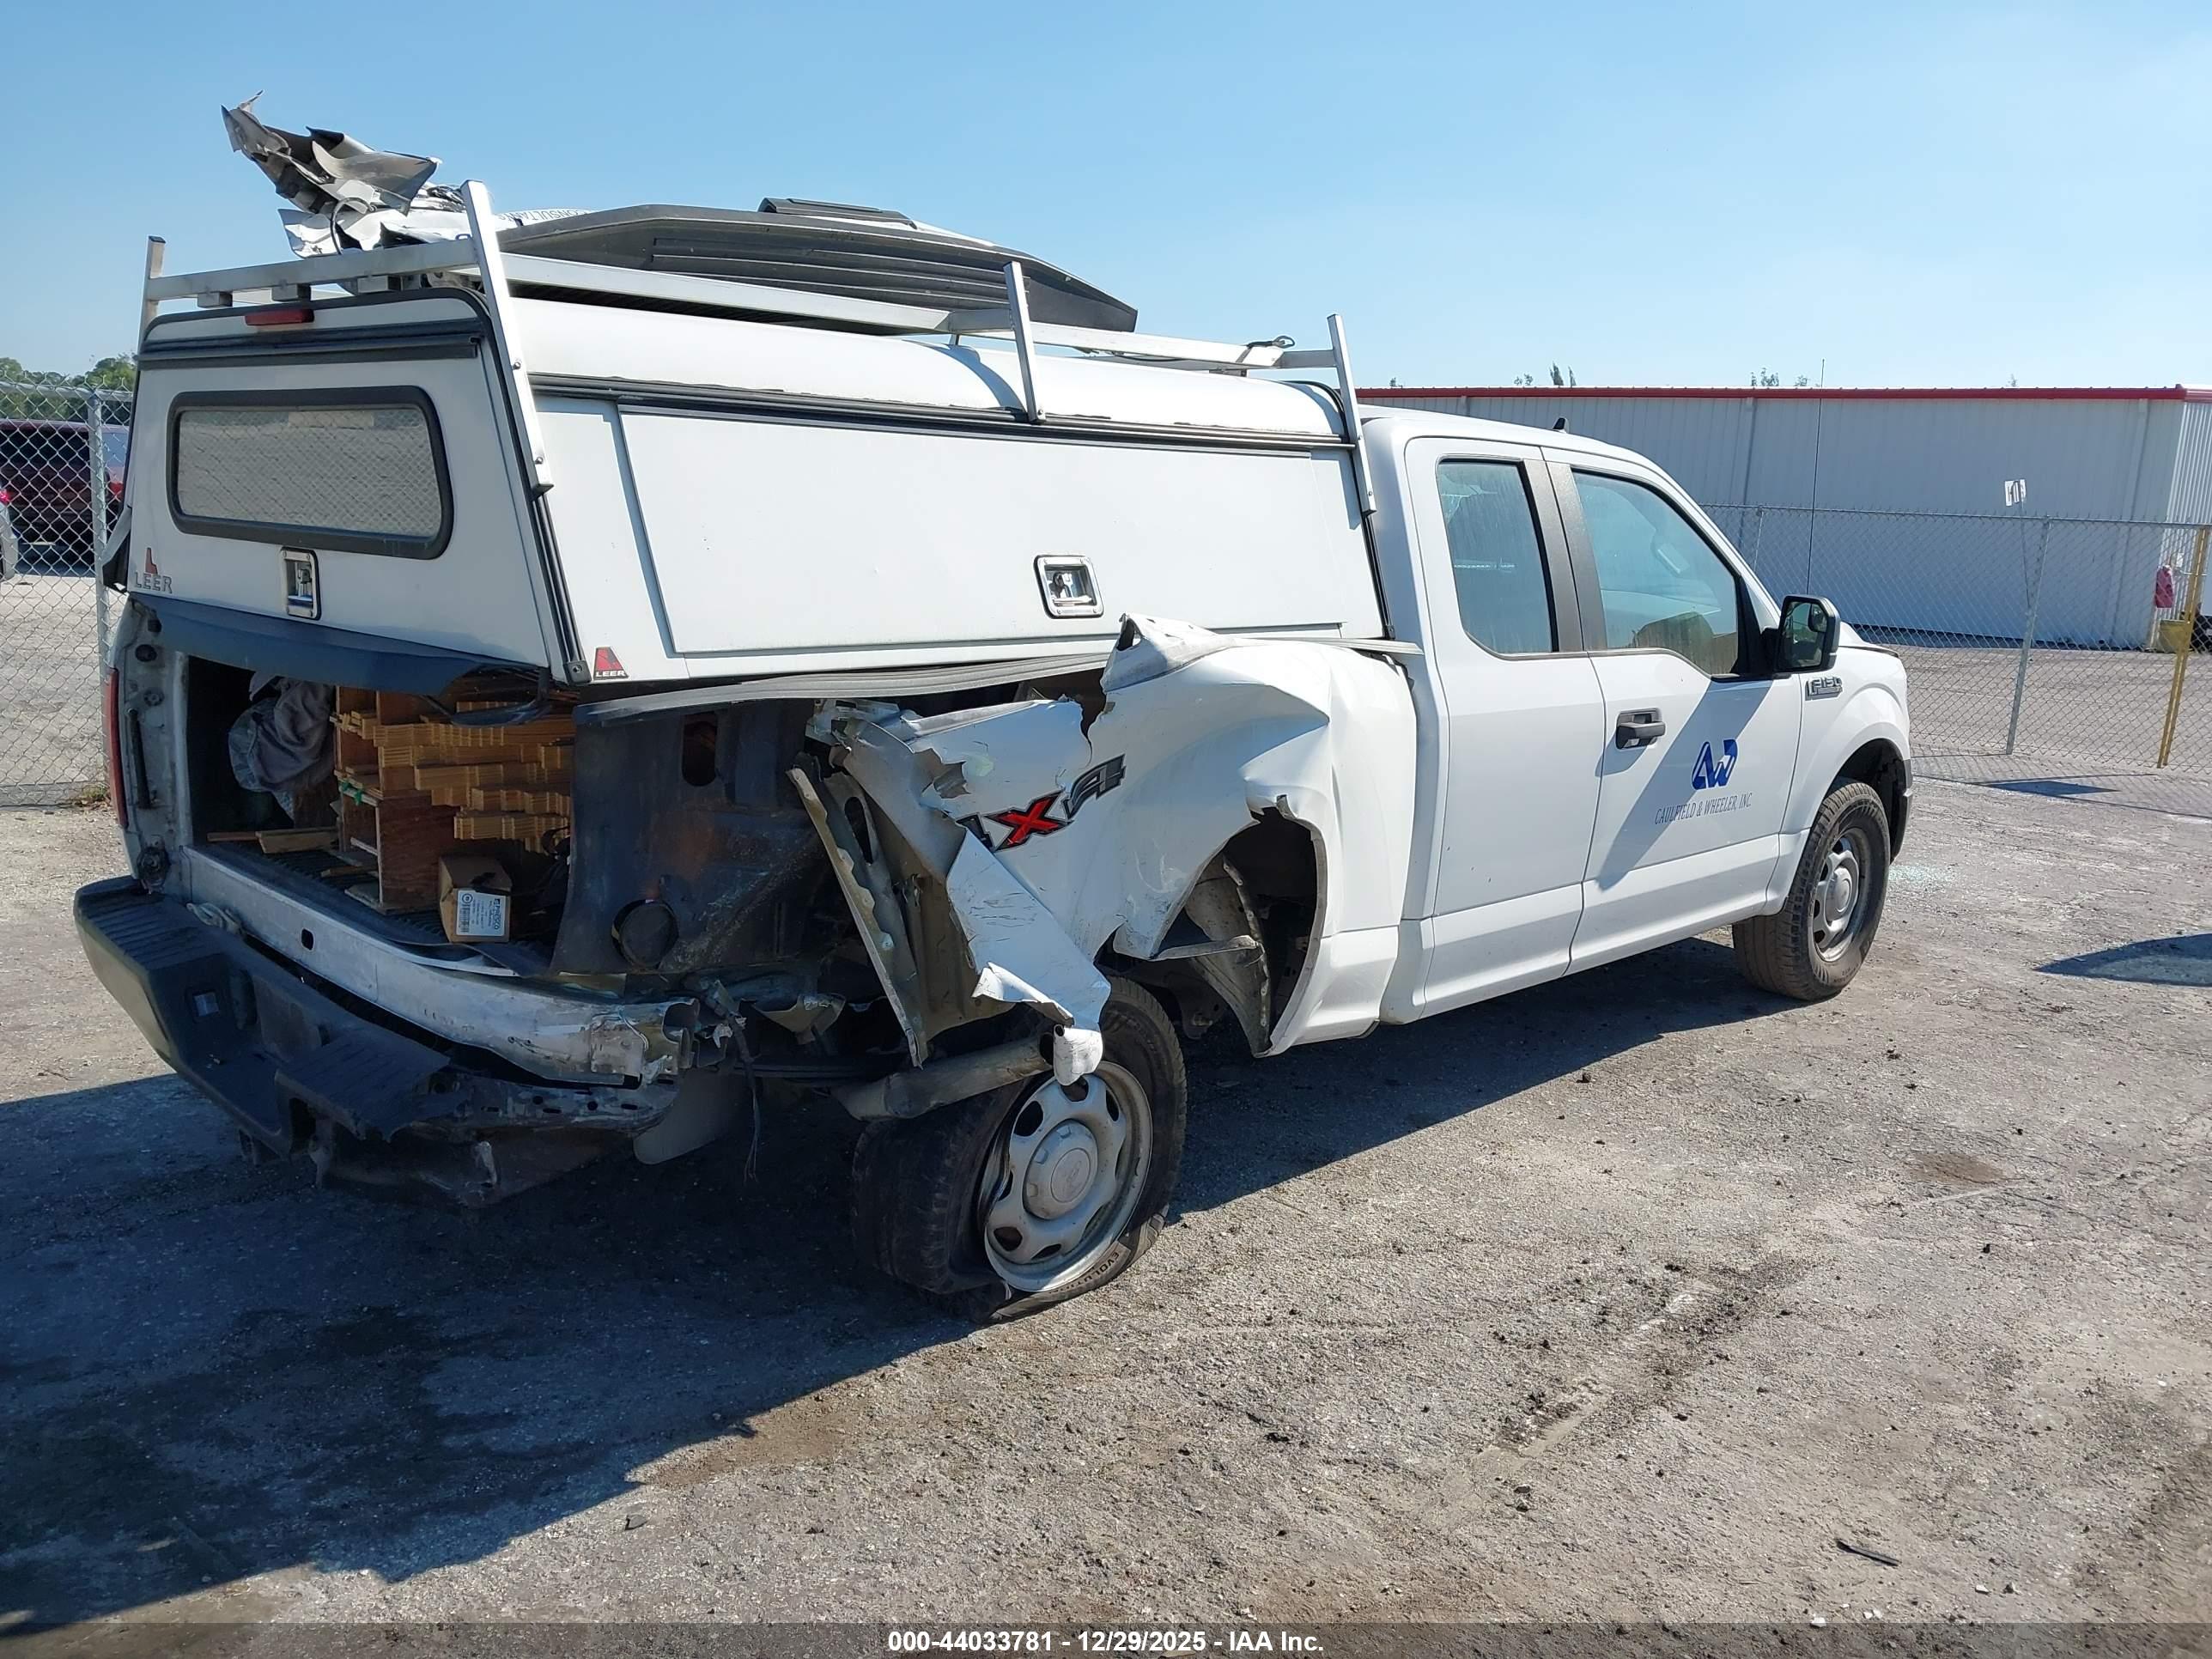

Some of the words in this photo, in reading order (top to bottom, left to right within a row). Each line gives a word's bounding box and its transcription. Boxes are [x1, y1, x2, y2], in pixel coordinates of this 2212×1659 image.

[135, 572, 173, 593] LEER
[1655, 803, 1697, 824] CAULFIELD
[1696, 801, 1704, 817] &
